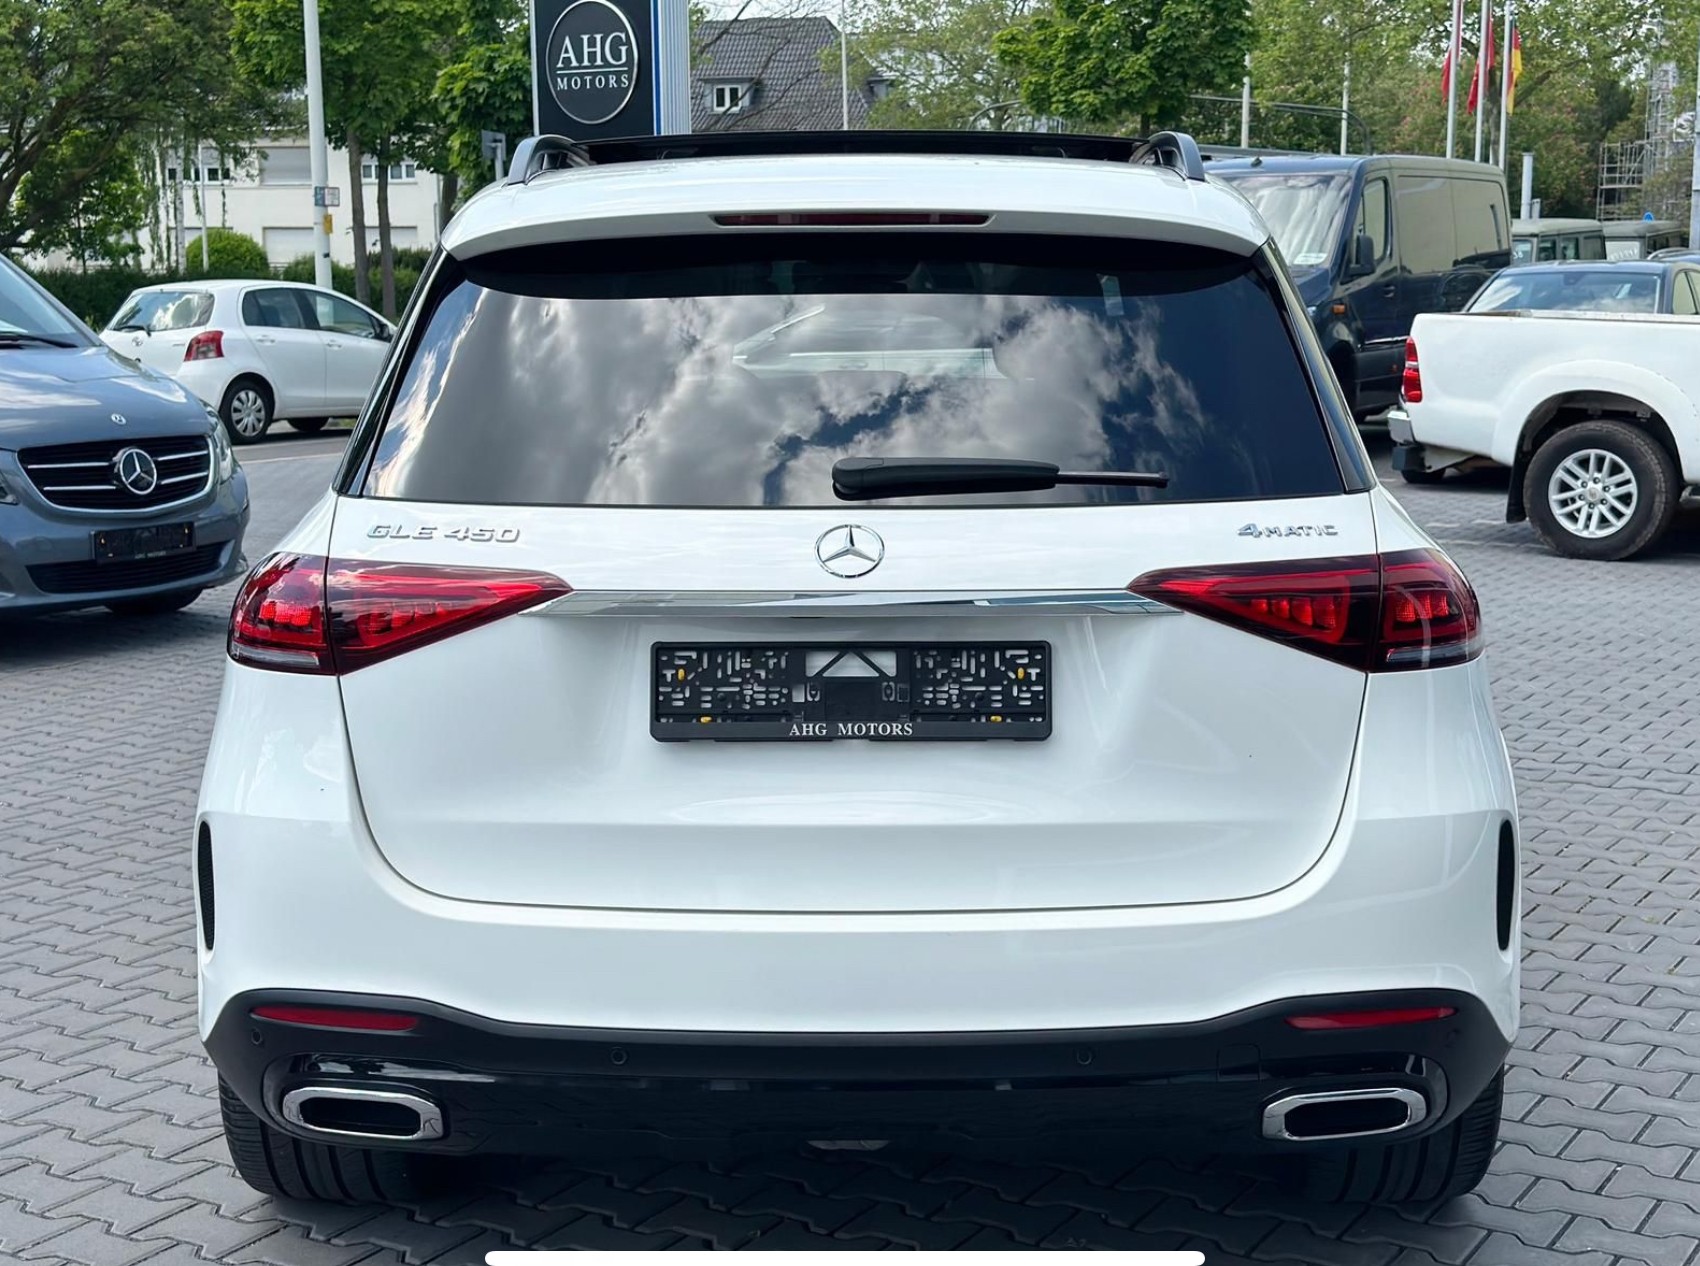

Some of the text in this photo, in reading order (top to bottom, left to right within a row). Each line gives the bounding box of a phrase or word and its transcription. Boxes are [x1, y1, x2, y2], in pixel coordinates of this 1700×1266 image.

[556, 32, 628, 68] AHG
[557, 74, 628, 90] MOTORS
[366, 524, 521, 543] GLE 450
[1237, 523, 1339, 538] 4MATIC
[789, 723, 913, 736] AHG MOTORS
